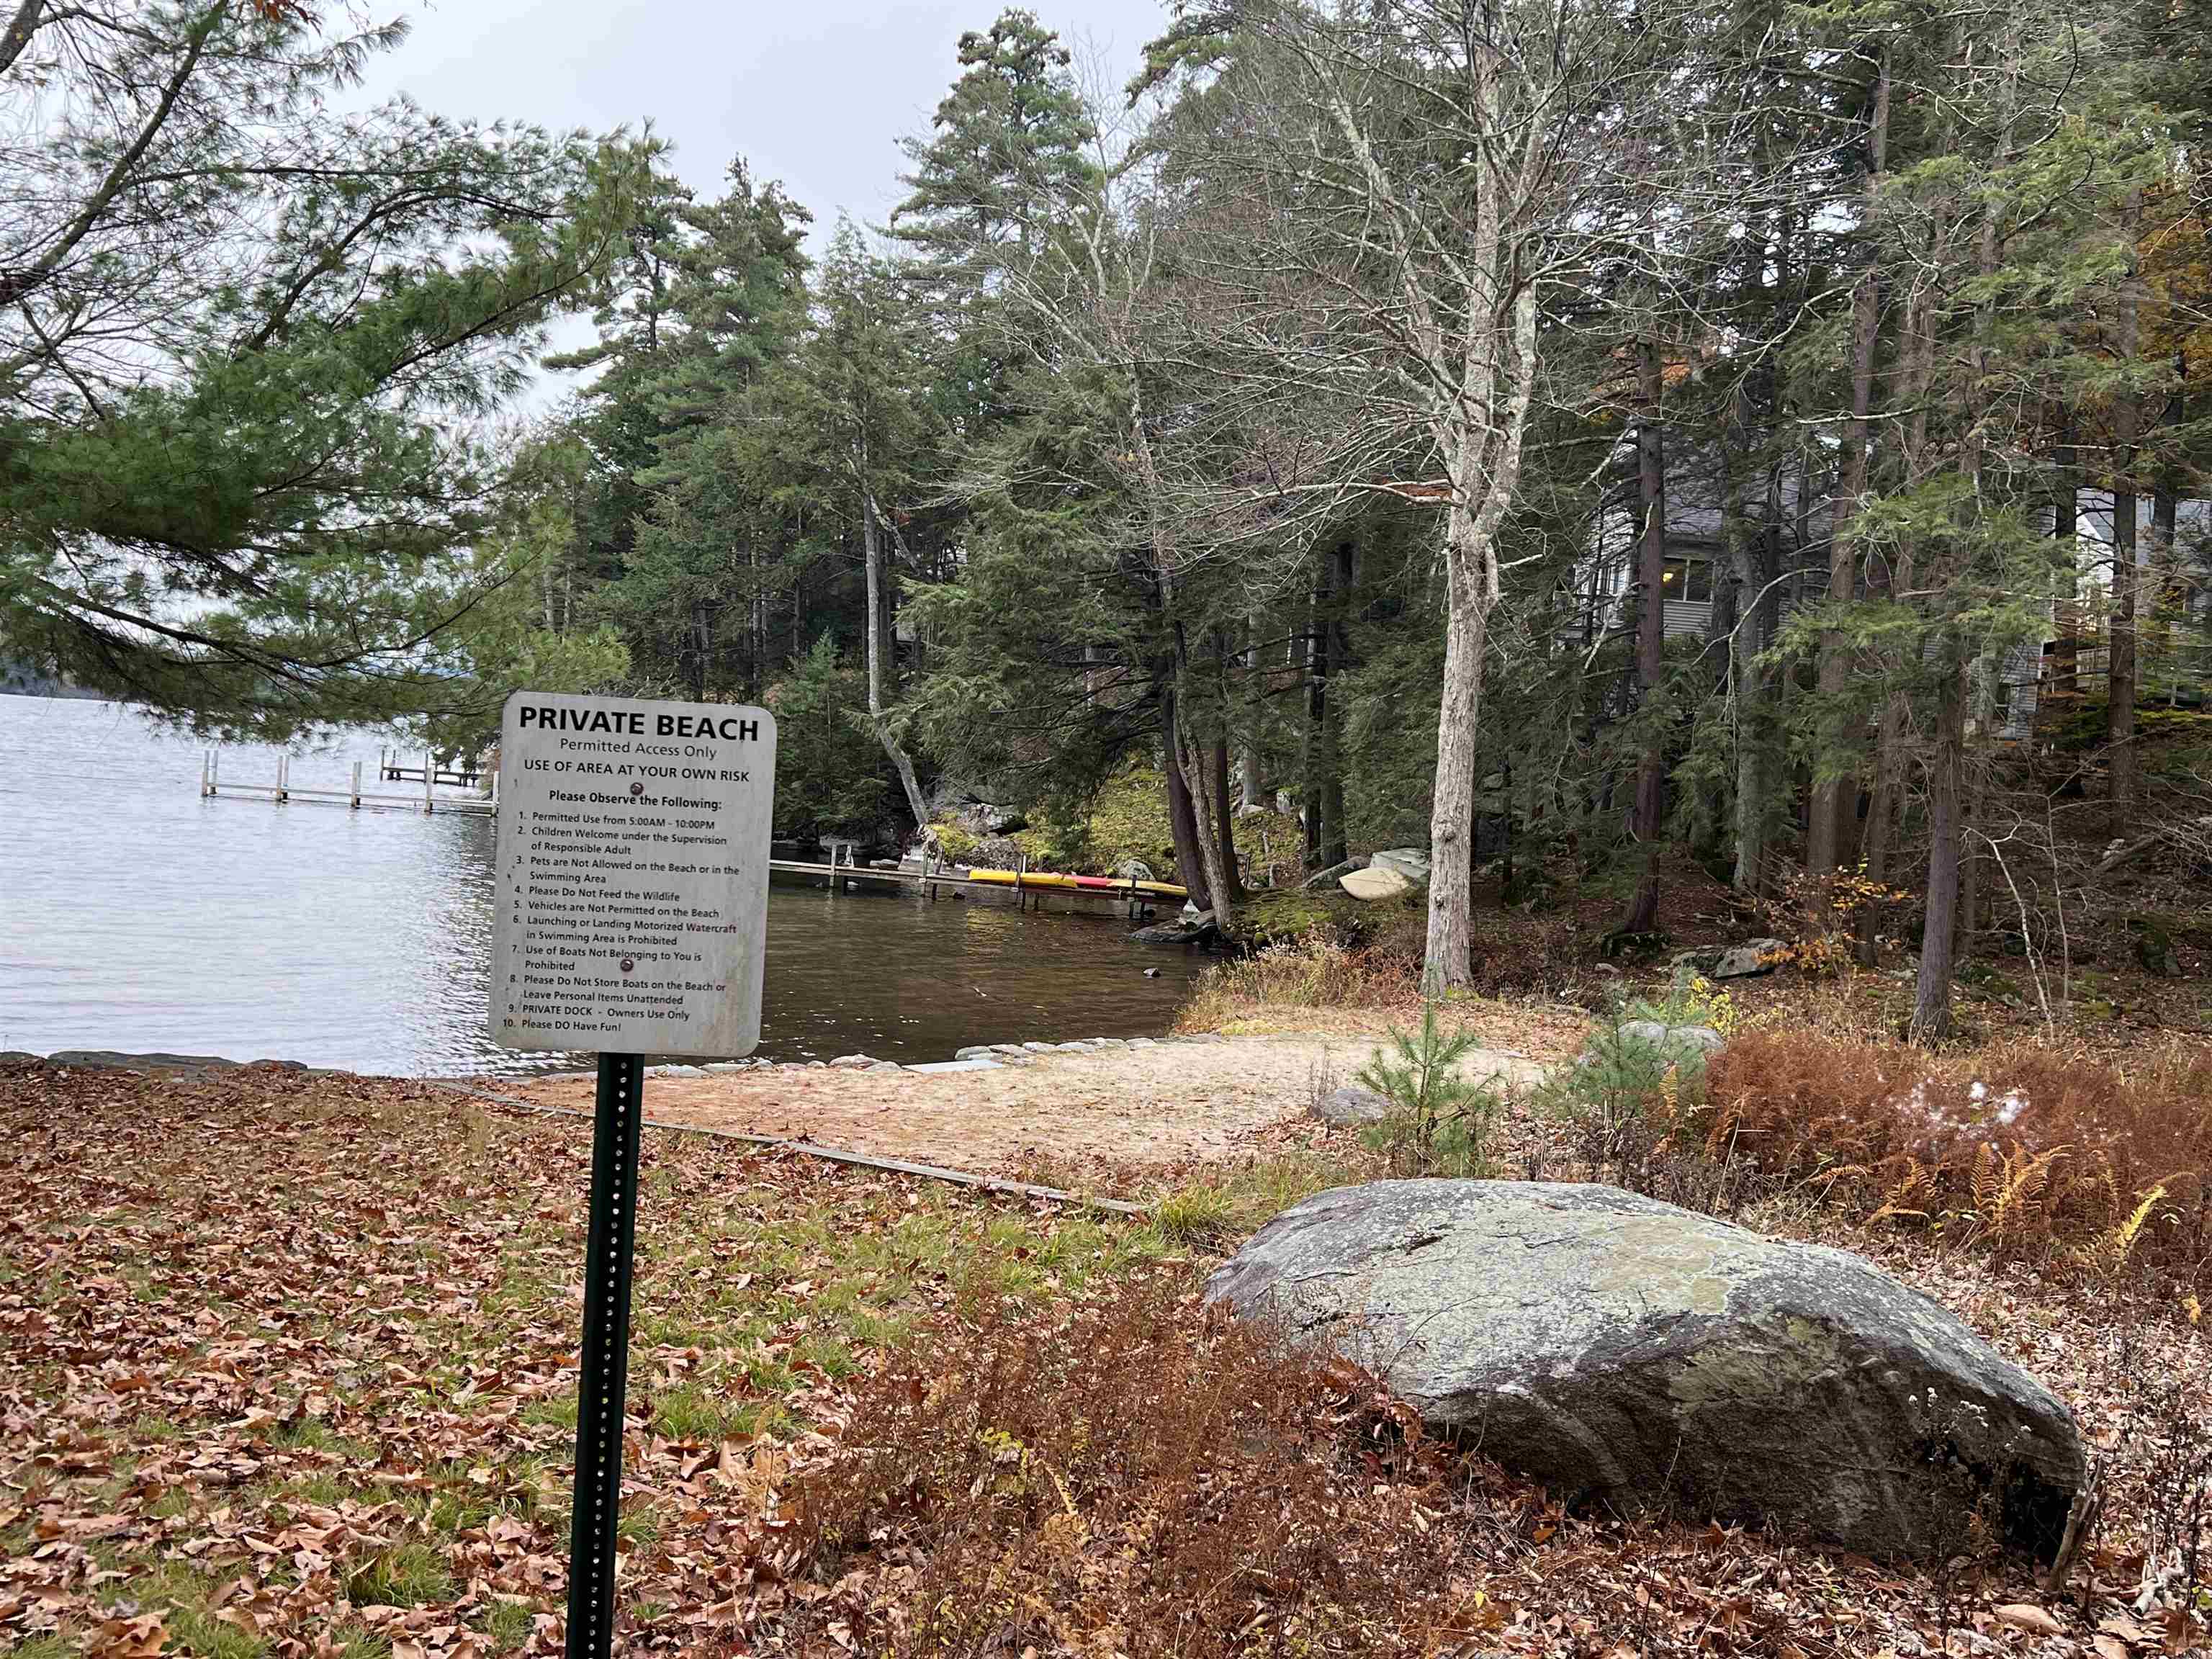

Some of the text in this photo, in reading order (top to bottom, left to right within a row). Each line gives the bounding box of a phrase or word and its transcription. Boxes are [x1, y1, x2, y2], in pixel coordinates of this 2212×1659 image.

[520, 706, 758, 743] PRIVATE BEACH
[560, 738, 716, 760] Permitted Access Only
[524, 759, 749, 782] USE OF AREA AT YOUR OWN RISK
[549, 790, 721, 811] Please Observe the Following:
[519, 811, 527, 819] 1.
[533, 812, 580, 822] Permitted
[583, 814, 601, 824] Use
[603, 815, 626, 824] from
[629, 817, 665, 827] 5:00AM
[675, 819, 714, 830] 10:00PM
[518, 826, 727, 845] 2. Children Welcome under the Supervision
[531, 841, 631, 855] of Responsible Adult
[516, 855, 524, 864] 3.
[531, 856, 550, 866] Pets
[571, 858, 589, 868] Not
[592, 860, 632, 869] Allowed
[649, 862, 666, 871] the
[668, 863, 696, 873] Beach
[712, 865, 721, 873] in
[724, 866, 739, 875] the
[530, 871, 606, 884] Swimming Area
[515, 885, 680, 902] 4. Please Do Not Feed the Wildlife
[514, 900, 522, 909] 5.
[529, 901, 567, 911] Vehicles
[608, 905, 655, 915] Permitted
[673, 907, 688, 918] the
[691, 909, 719, 917] Beach
[528, 916, 577, 929] Launching
[593, 919, 631, 931] Landing
[634, 920, 683, 931] Motorized
[686, 923, 737, 933] Watercraft
[527, 930, 677, 945] in Swimming Area is Prohibited
[513, 945, 520, 953] 7.
[526, 945, 543, 954] Use
[547, 946, 557, 955] of
[559, 947, 586, 956] Boats
[589, 948, 606, 957] Not
[610, 949, 657, 961] Belonging
[673, 952, 691, 961] You
[694, 953, 701, 961] is
[525, 961, 575, 971] Prohibited
[510, 974, 518, 983] 8.
[524, 975, 554, 984] Please
[557, 976, 570, 985] Do
[574, 977, 592, 986] Not
[594, 978, 619, 988] Store
[623, 979, 648, 988] Boats
[667, 981, 683, 990] the
[685, 980, 714, 991] Beach
[524, 989, 684, 1005] Leave Personal Items Unattended
[509, 1004, 516, 1012] 9.
[523, 1004, 562, 1014] PRIVATE
[565, 1007, 592, 1015] DOCK
[607, 1008, 644, 1018] Owners
[647, 1010, 665, 1019] Use
[667, 1010, 690, 1022] Only
[503, 1019, 621, 1031] 10. Please DO Have Fun!
